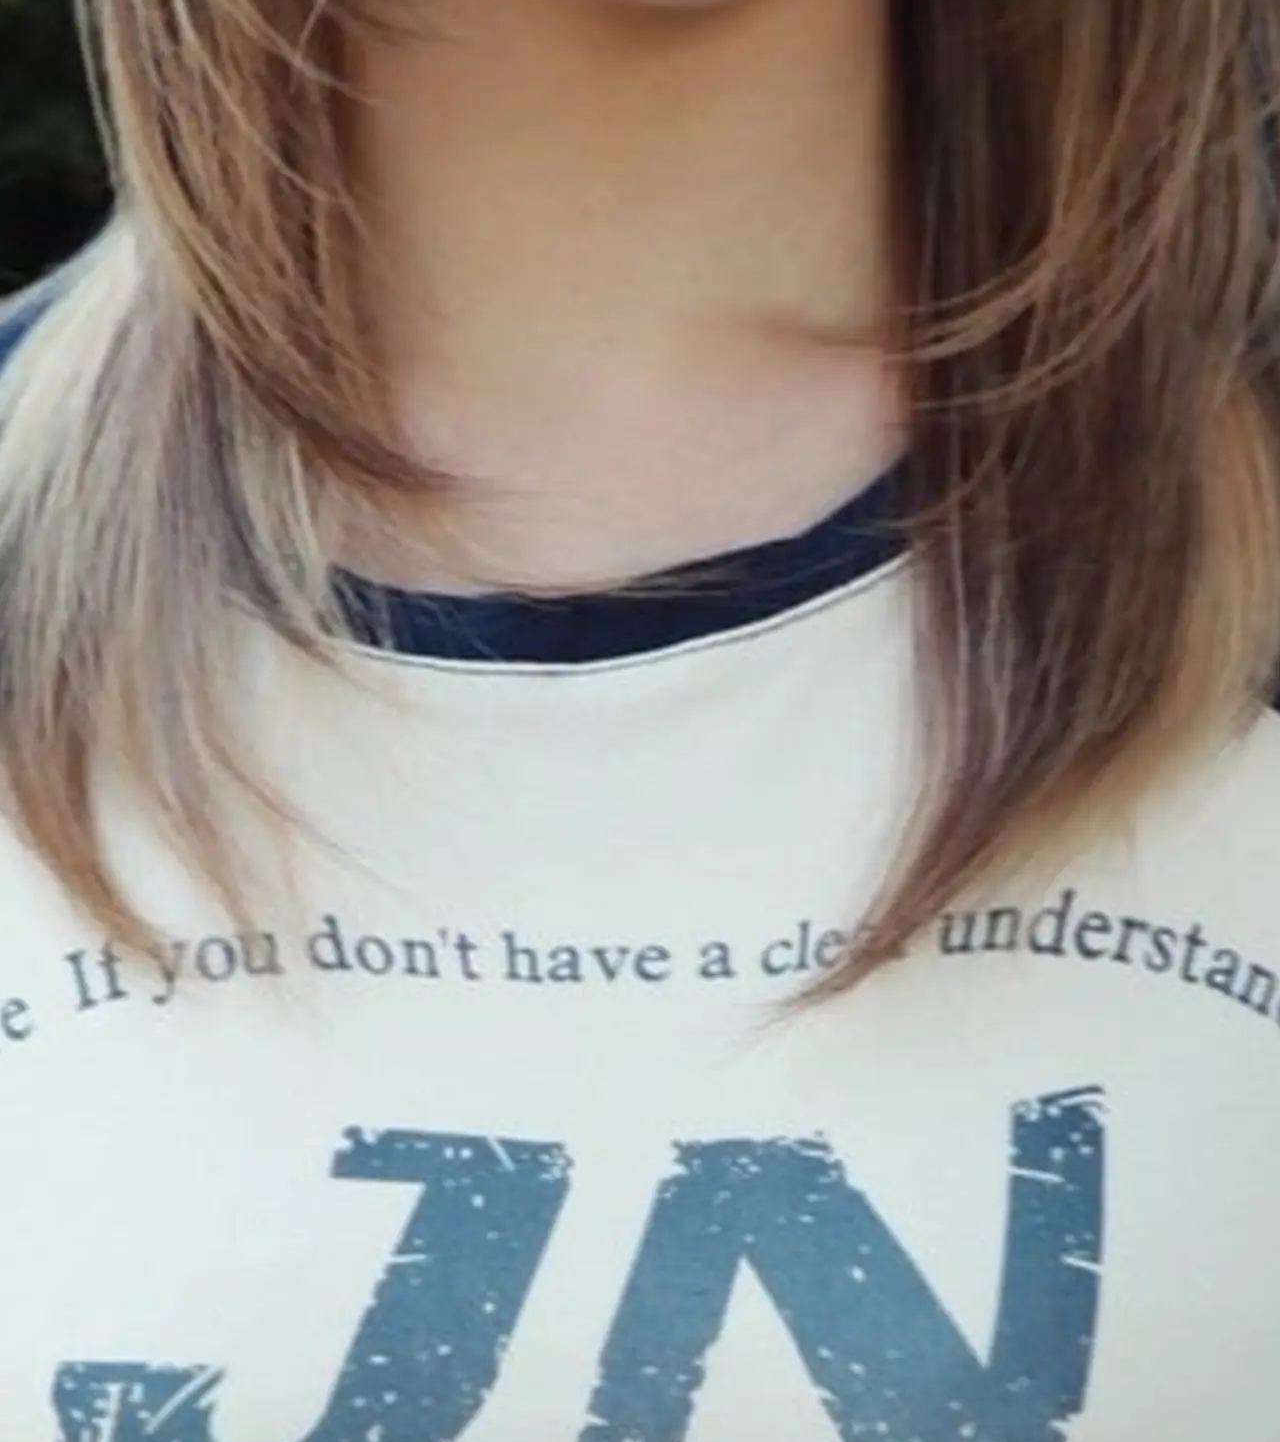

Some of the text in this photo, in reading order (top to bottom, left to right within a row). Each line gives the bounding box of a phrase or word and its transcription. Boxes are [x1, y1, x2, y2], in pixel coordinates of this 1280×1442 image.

[63, 933, 127, 1009] If
[151, 931, 284, 1005] you
[307, 914, 481, 980] don't
[500, 930, 672, 984] have
[698, 939, 736, 980] a
[760, 919, 898, 977] cle
